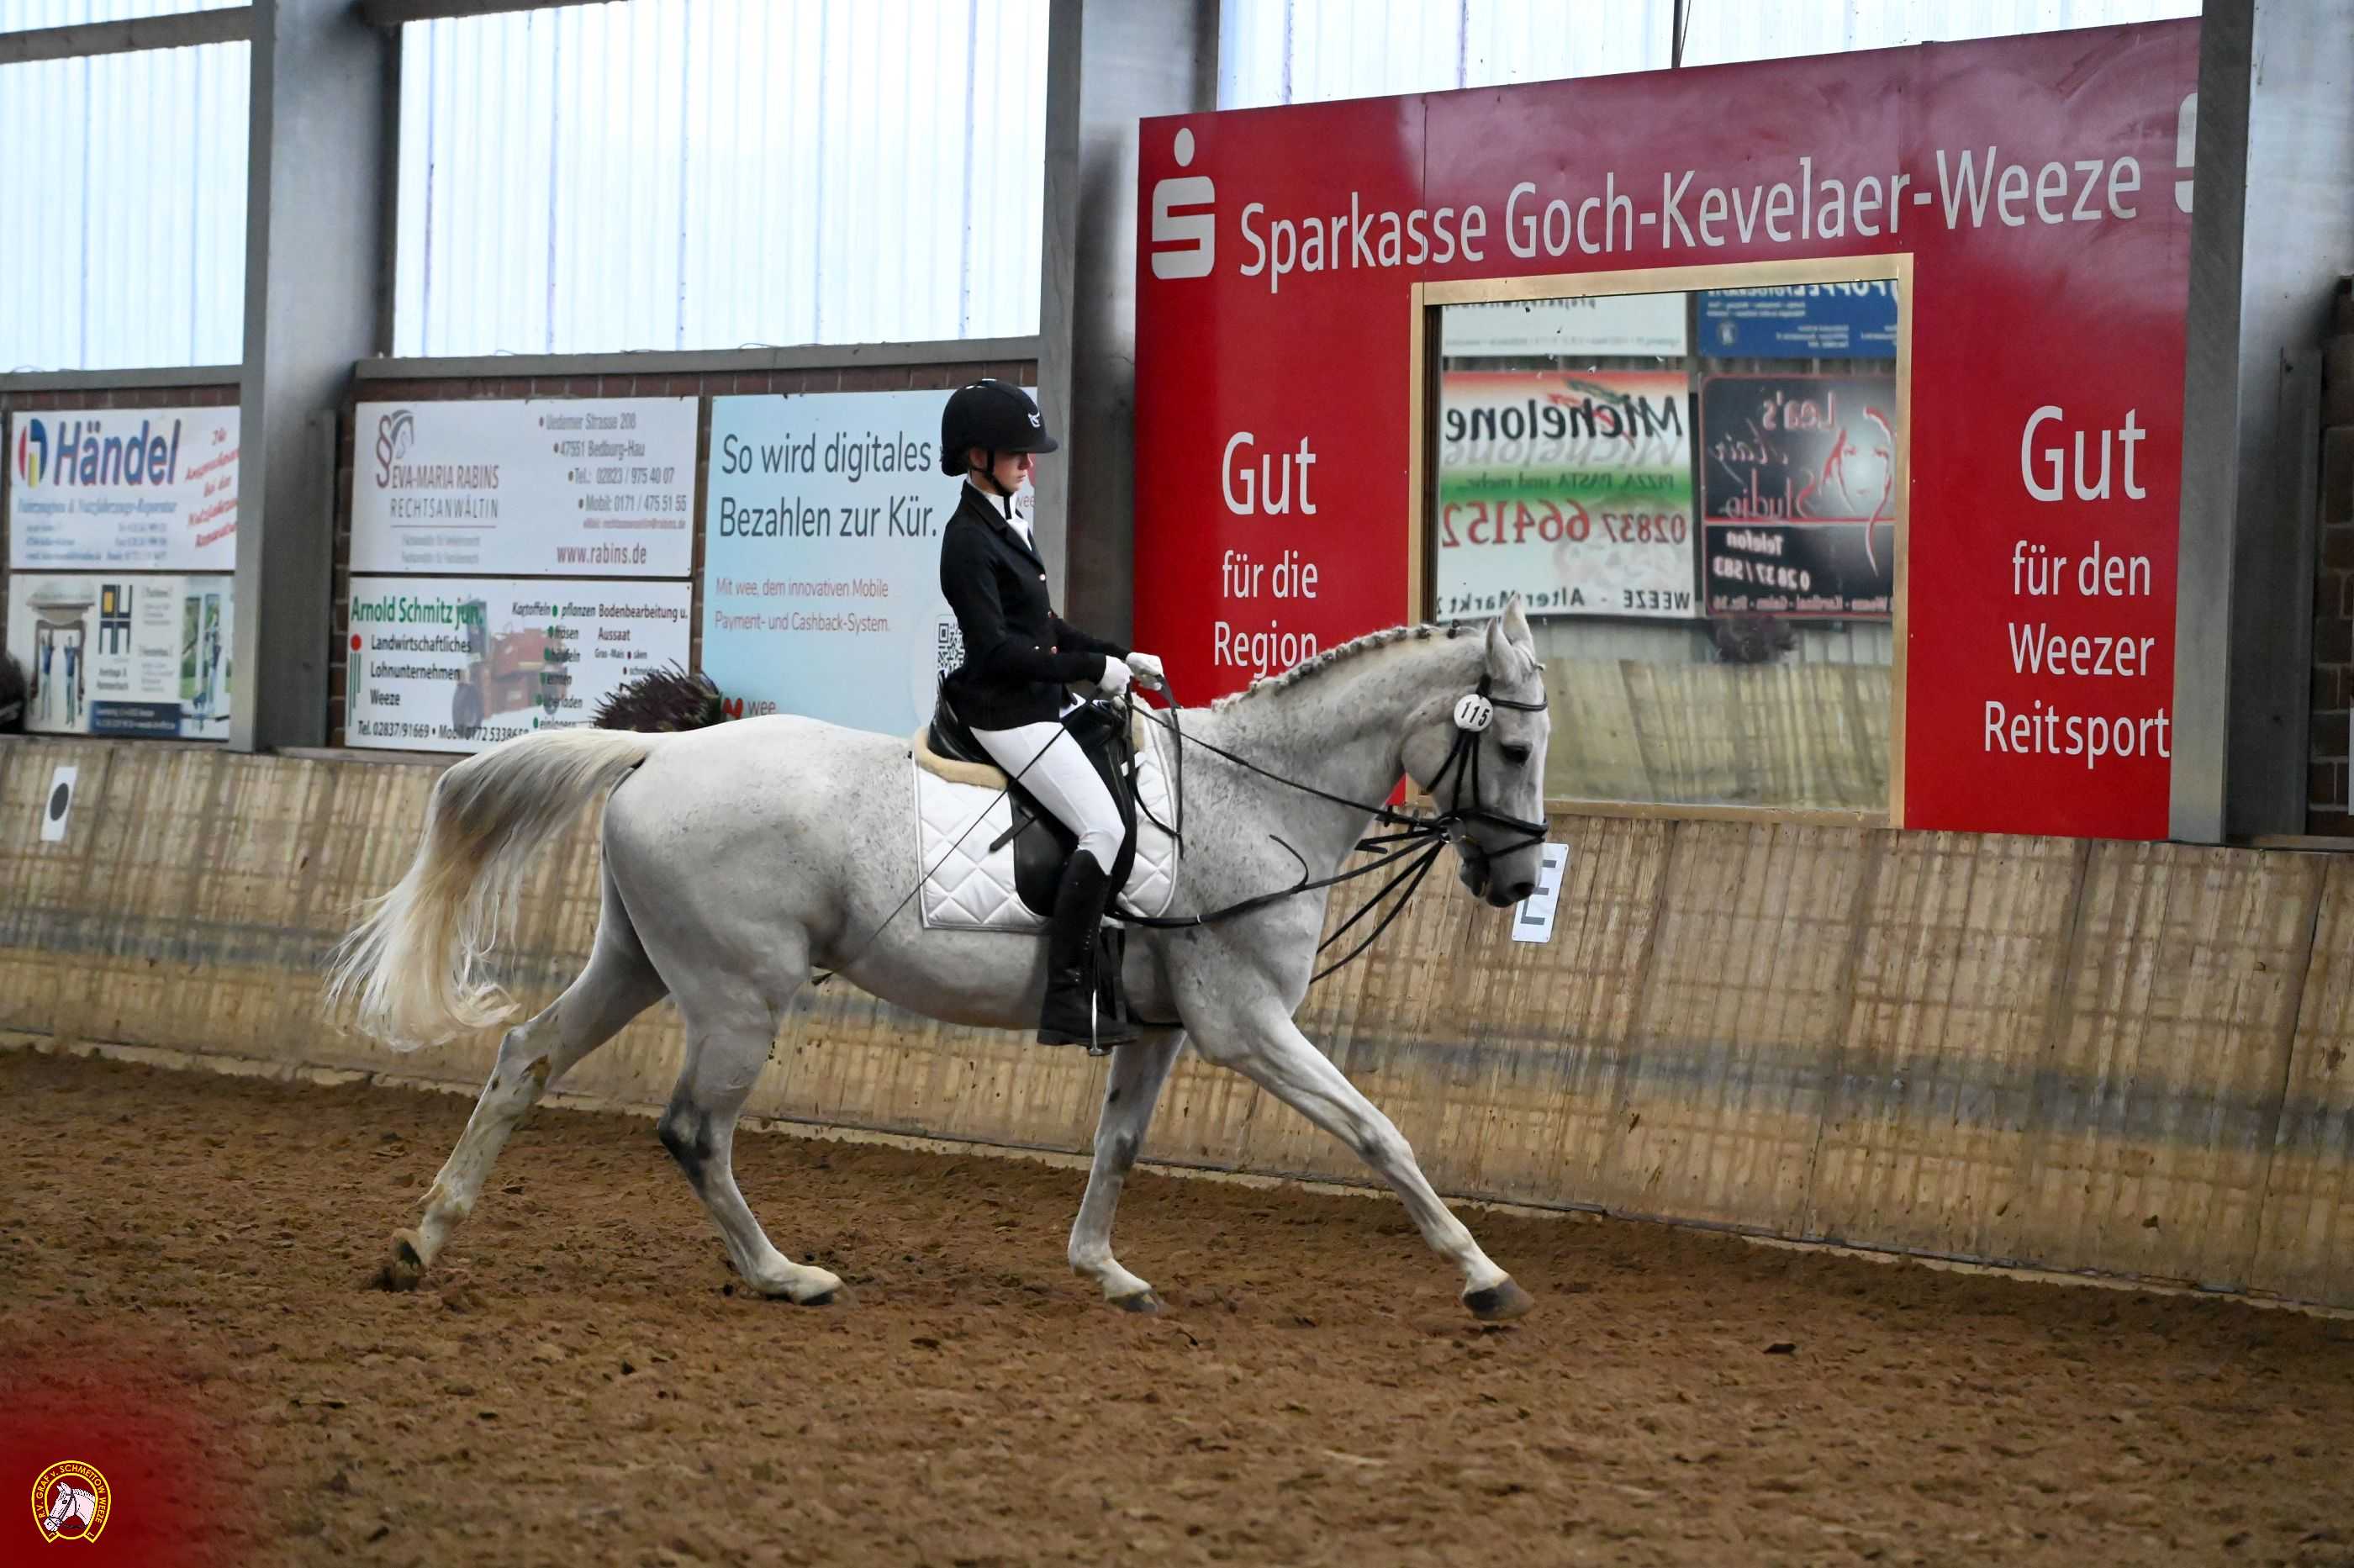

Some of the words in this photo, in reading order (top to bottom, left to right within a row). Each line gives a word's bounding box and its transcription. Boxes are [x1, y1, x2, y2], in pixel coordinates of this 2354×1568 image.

[1239, 192, 1487, 293] Sparkasse
[1505, 145, 2142, 260] Goch-Kevelaer-Weeze
[53, 418, 182, 487] Händel
[721, 433, 752, 475] So
[762, 432, 815, 474] wird
[825, 431, 932, 483] digitales
[2021, 405, 2146, 502] Gut
[392, 465, 454, 489] EVA-MARIA
[457, 465, 499, 489] RABINS
[1222, 431, 1317, 515] Gut
[390, 494, 498, 519] RECHTSANWÄLTIN
[615, 494, 634, 511] 0171
[645, 494, 660, 511] 475
[662, 495, 673, 511] 51
[720, 496, 831, 537] Bezahlen
[841, 507, 881, 537] zur
[889, 494, 938, 538] Kür.
[557, 542, 647, 565] www.rabins.de
[1222, 550, 1264, 598] für
[1272, 550, 1318, 599] die
[2012, 540, 2067, 595] für
[2078, 540, 2151, 596] den
[715, 578, 732, 597] Mit
[762, 578, 786, 597] dem
[788, 578, 850, 597] innovativen
[852, 578, 889, 598] Mobile
[351, 595, 396, 623] Arnold
[399, 596, 452, 624] Schmitz
[455, 597, 483, 630] jun.
[599, 603, 678, 622] Bodenbearbeitung
[680, 608, 688, 619] u.
[715, 611, 766, 632] Payment-
[768, 613, 789, 631] und
[371, 634, 472, 653] Landwirtschaftliches
[598, 626, 631, 641] Aussaat
[1214, 620, 1317, 678] Region
[2008, 622, 2155, 676] Weezer
[371, 660, 462, 680] Lohnunternehmen
[370, 689, 400, 706] Weeze
[747, 700, 776, 715] wee
[1461, 701, 1490, 726] 115
[357, 720, 371, 736] Tel.
[1984, 700, 2170, 769] Reitsport
